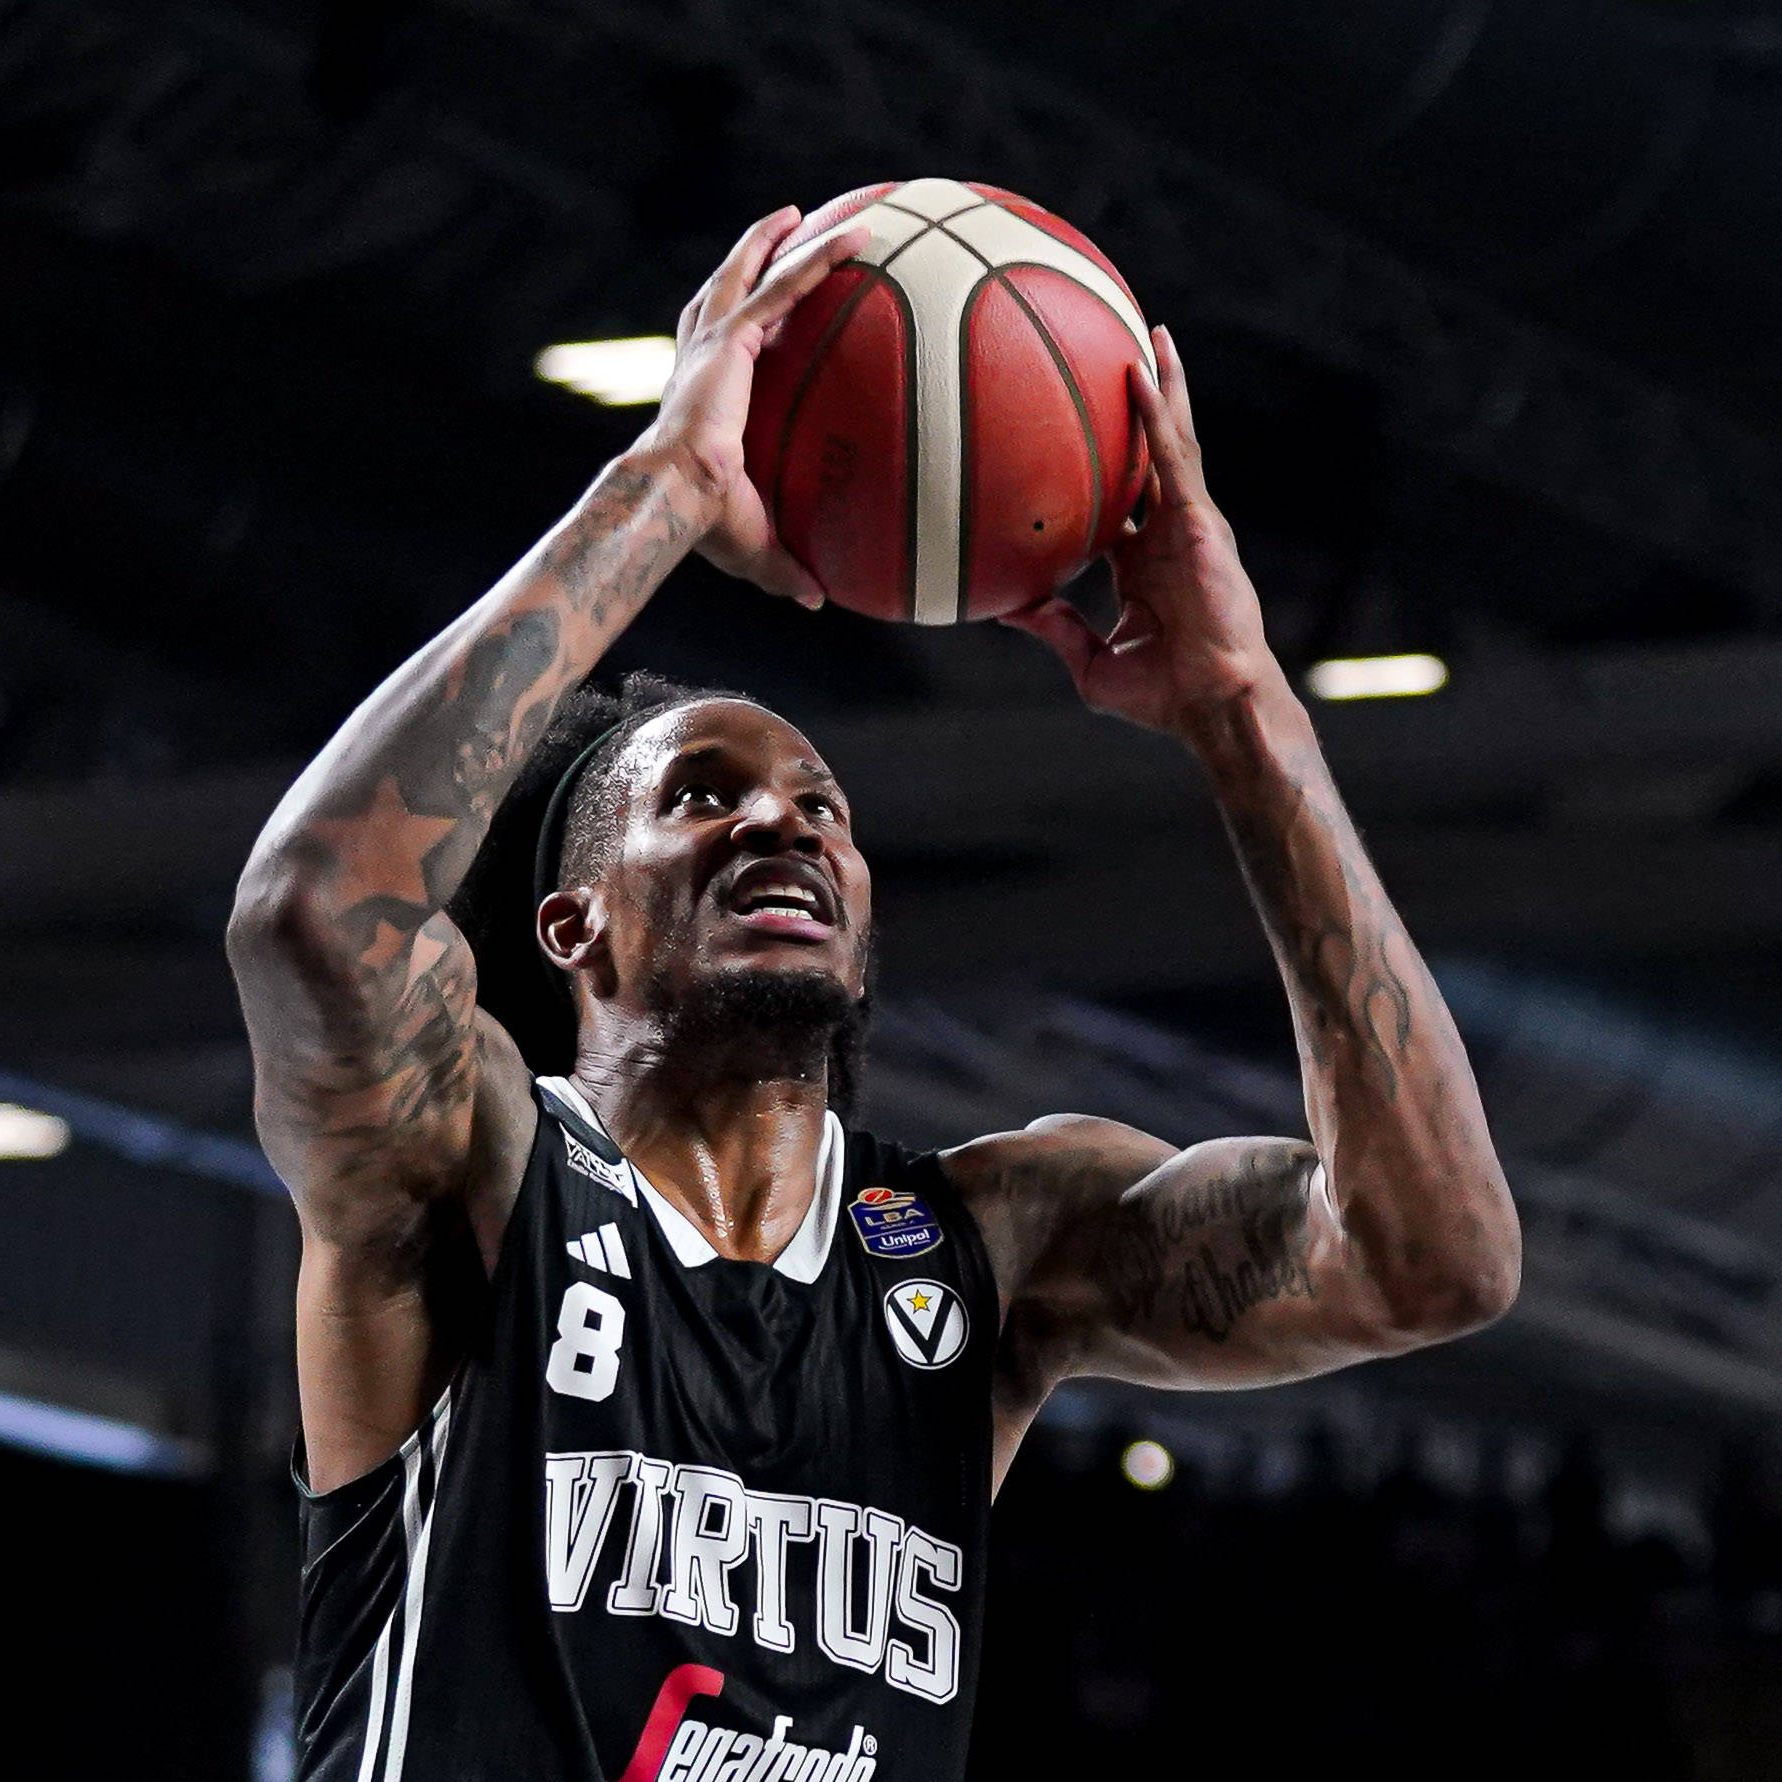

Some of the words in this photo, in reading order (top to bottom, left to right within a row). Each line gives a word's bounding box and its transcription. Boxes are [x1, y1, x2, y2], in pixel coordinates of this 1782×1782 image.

[864, 1208, 925, 1227] LBA
[880, 1229, 931, 1247] Unipol
[545, 1280, 625, 1402] 8
[544, 1450, 962, 1706] VIRTUS
